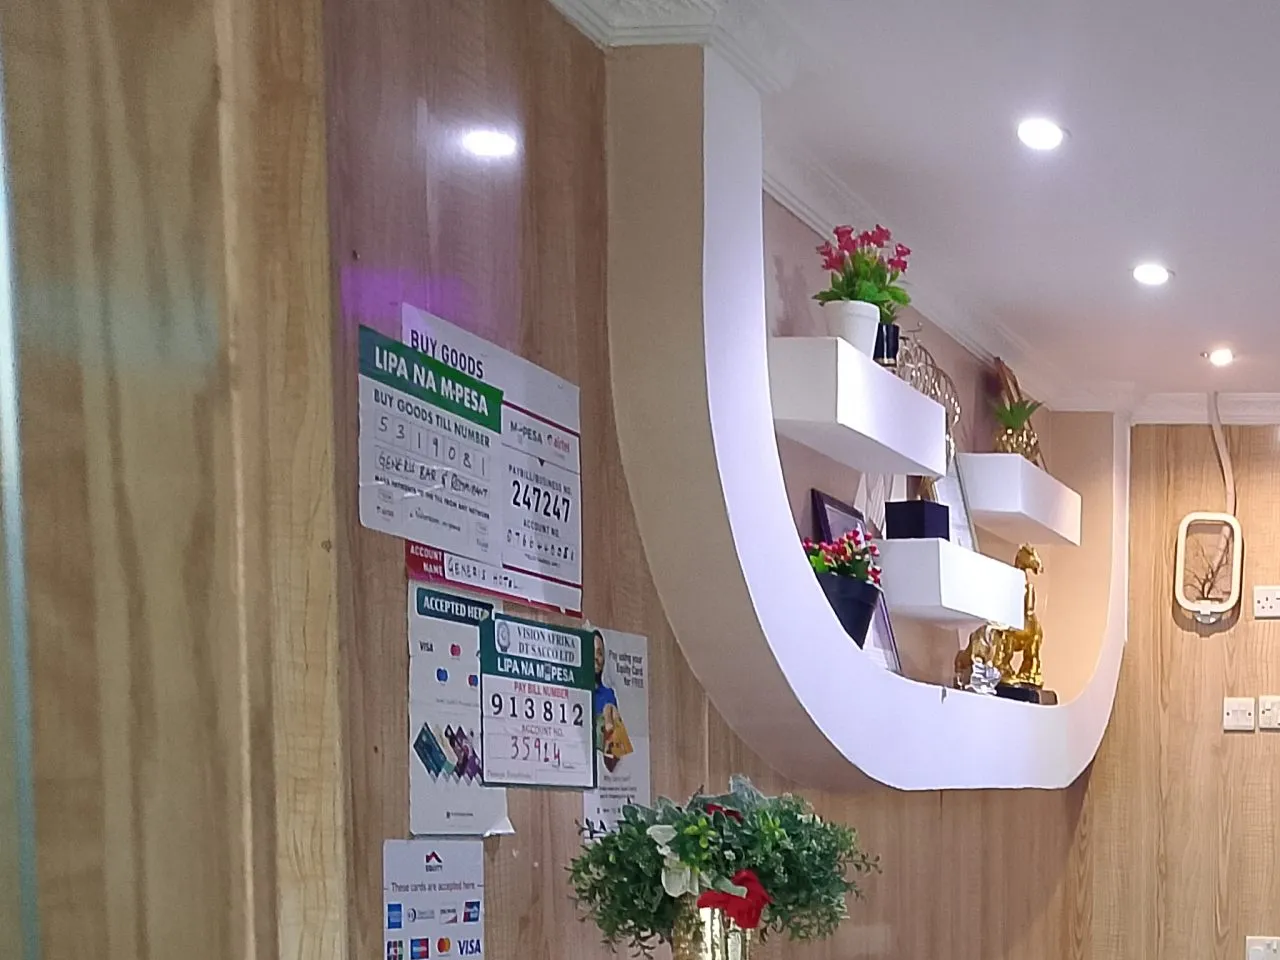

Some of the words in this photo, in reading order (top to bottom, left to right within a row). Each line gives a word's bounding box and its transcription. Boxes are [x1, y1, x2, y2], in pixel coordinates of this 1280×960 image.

[411, 329, 438, 360] BUY
[441, 344, 484, 379] GOODS
[375, 346, 409, 381] LIPA
[413, 363, 437, 393] NA
[374, 388, 394, 409] BUY
[397, 399, 433, 425] GOODS
[435, 414, 452, 432] TILL
[454, 422, 490, 448] NUMBER
[512, 479, 570, 523] 247247
[410, 545, 443, 561] ACCOUNT
[423, 561, 443, 577] NAME
[424, 595, 467, 617] ACCEPTED
[517, 626, 546, 642] VISION
[547, 634, 576, 649] AFRIKA
[497, 657, 520, 676] LIPA
[521, 661, 535, 677] NA
[514, 681, 526, 693] PAY
[527, 683, 542, 696] BILL
[543, 685, 569, 700] NUMBER
[491, 693, 584, 727] 913812
[522, 725, 552, 737] ACCOUNT
[457, 939, 481, 956] VISA
